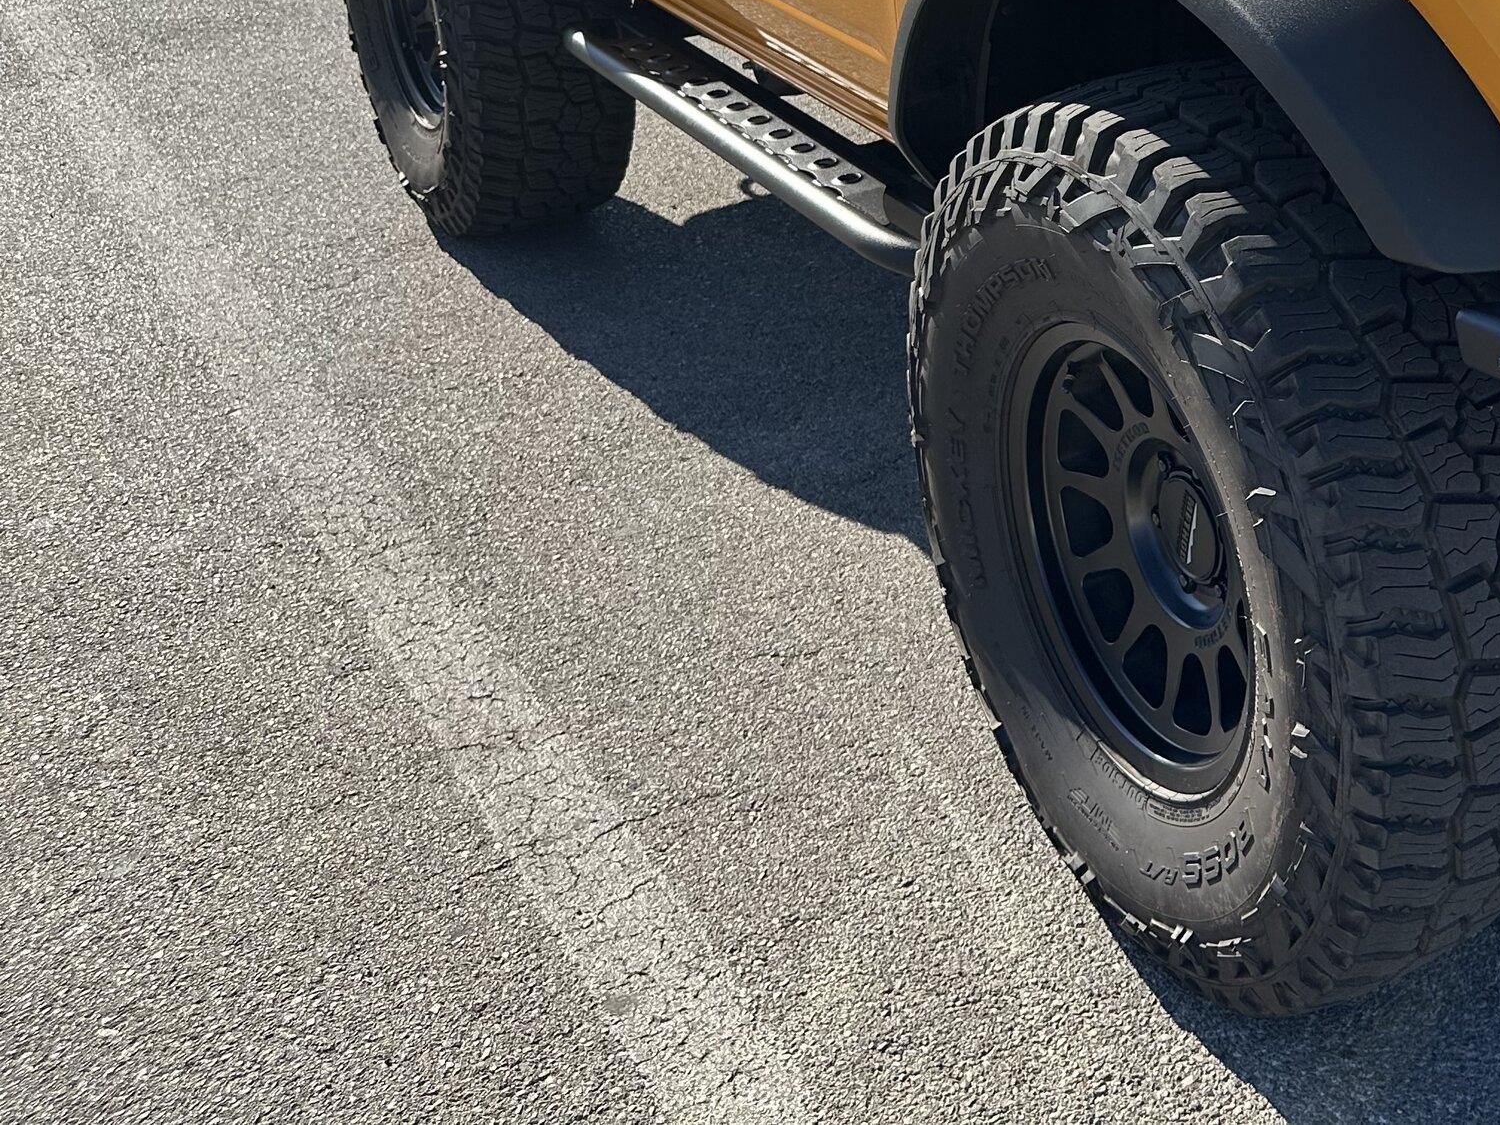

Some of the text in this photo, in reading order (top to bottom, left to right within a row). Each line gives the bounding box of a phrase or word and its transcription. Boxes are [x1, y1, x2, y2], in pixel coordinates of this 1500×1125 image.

[953, 257, 1056, 377] THOMPSON
[1093, 752, 1147, 809] OUTSIDE
[1182, 821, 1256, 889] BOSS
